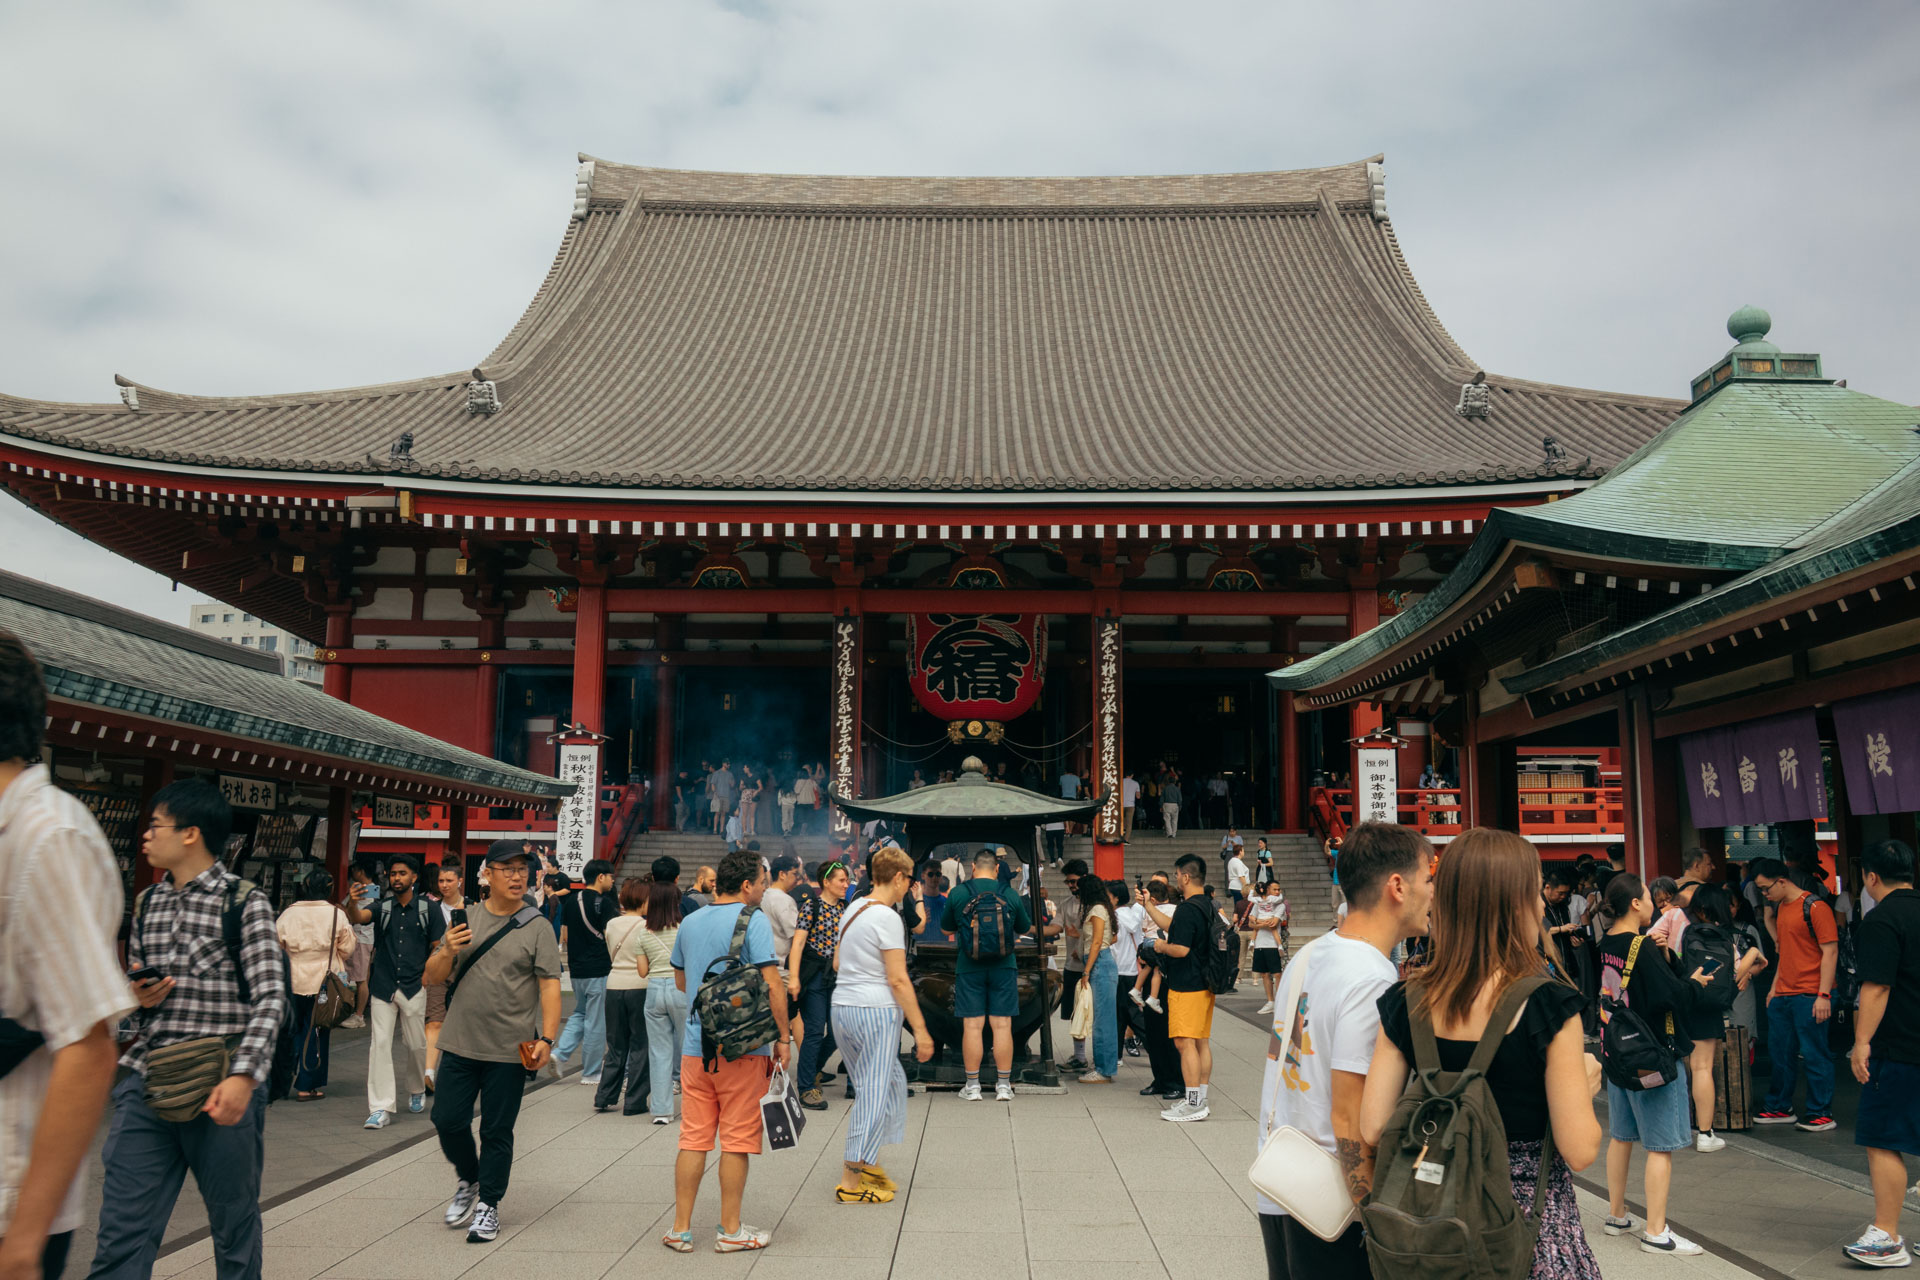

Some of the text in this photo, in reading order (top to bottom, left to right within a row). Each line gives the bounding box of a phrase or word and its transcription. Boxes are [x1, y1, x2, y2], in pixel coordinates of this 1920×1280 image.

[567, 753, 592, 762] 恒例
[1364, 759, 1389, 768] 恒例
[222, 778, 273, 808] お札お守
[1370, 773, 1387, 823] 御本尊御縁
[377, 800, 411, 822] お札お守
[1604, 952, 1628, 969] DONU
